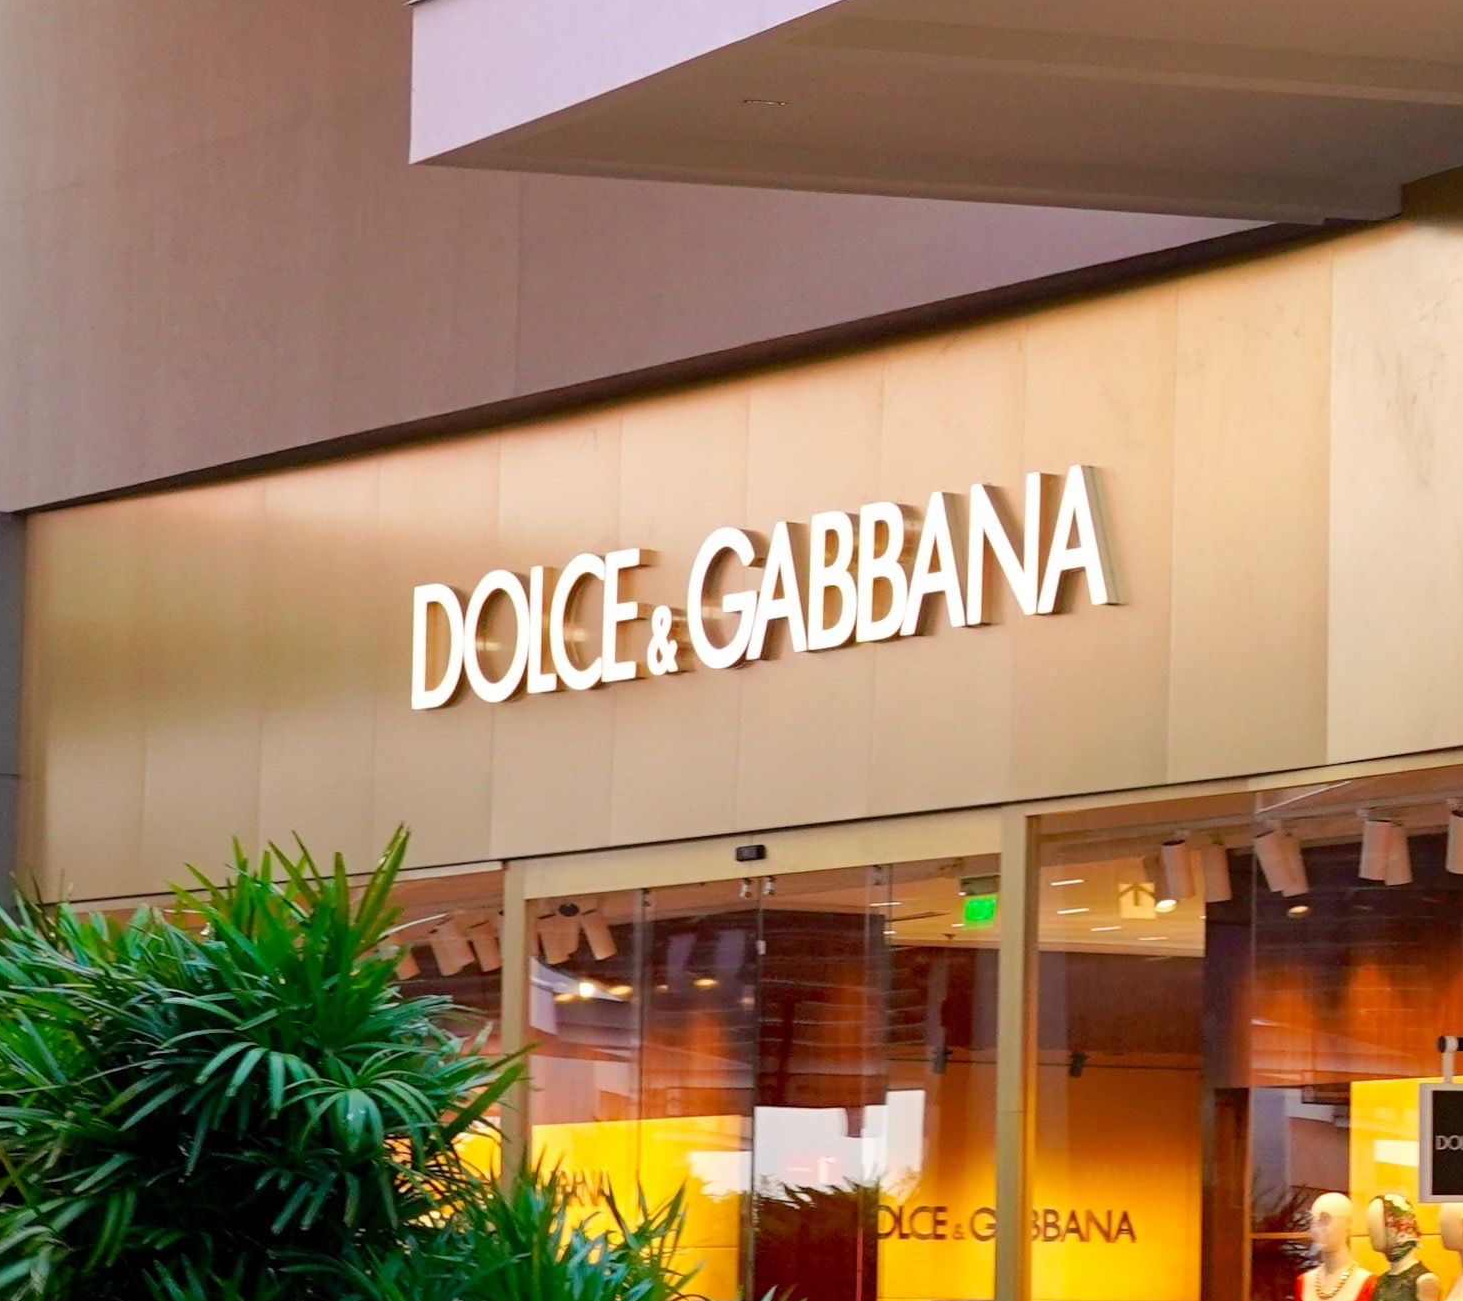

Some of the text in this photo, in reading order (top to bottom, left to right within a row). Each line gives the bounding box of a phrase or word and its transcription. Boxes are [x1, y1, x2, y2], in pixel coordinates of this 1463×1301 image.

[410, 463, 1119, 711] DOLCE & GABBANA
[878, 1204, 948, 1241] OLCE
[970, 1206, 1137, 1244] GBANA
